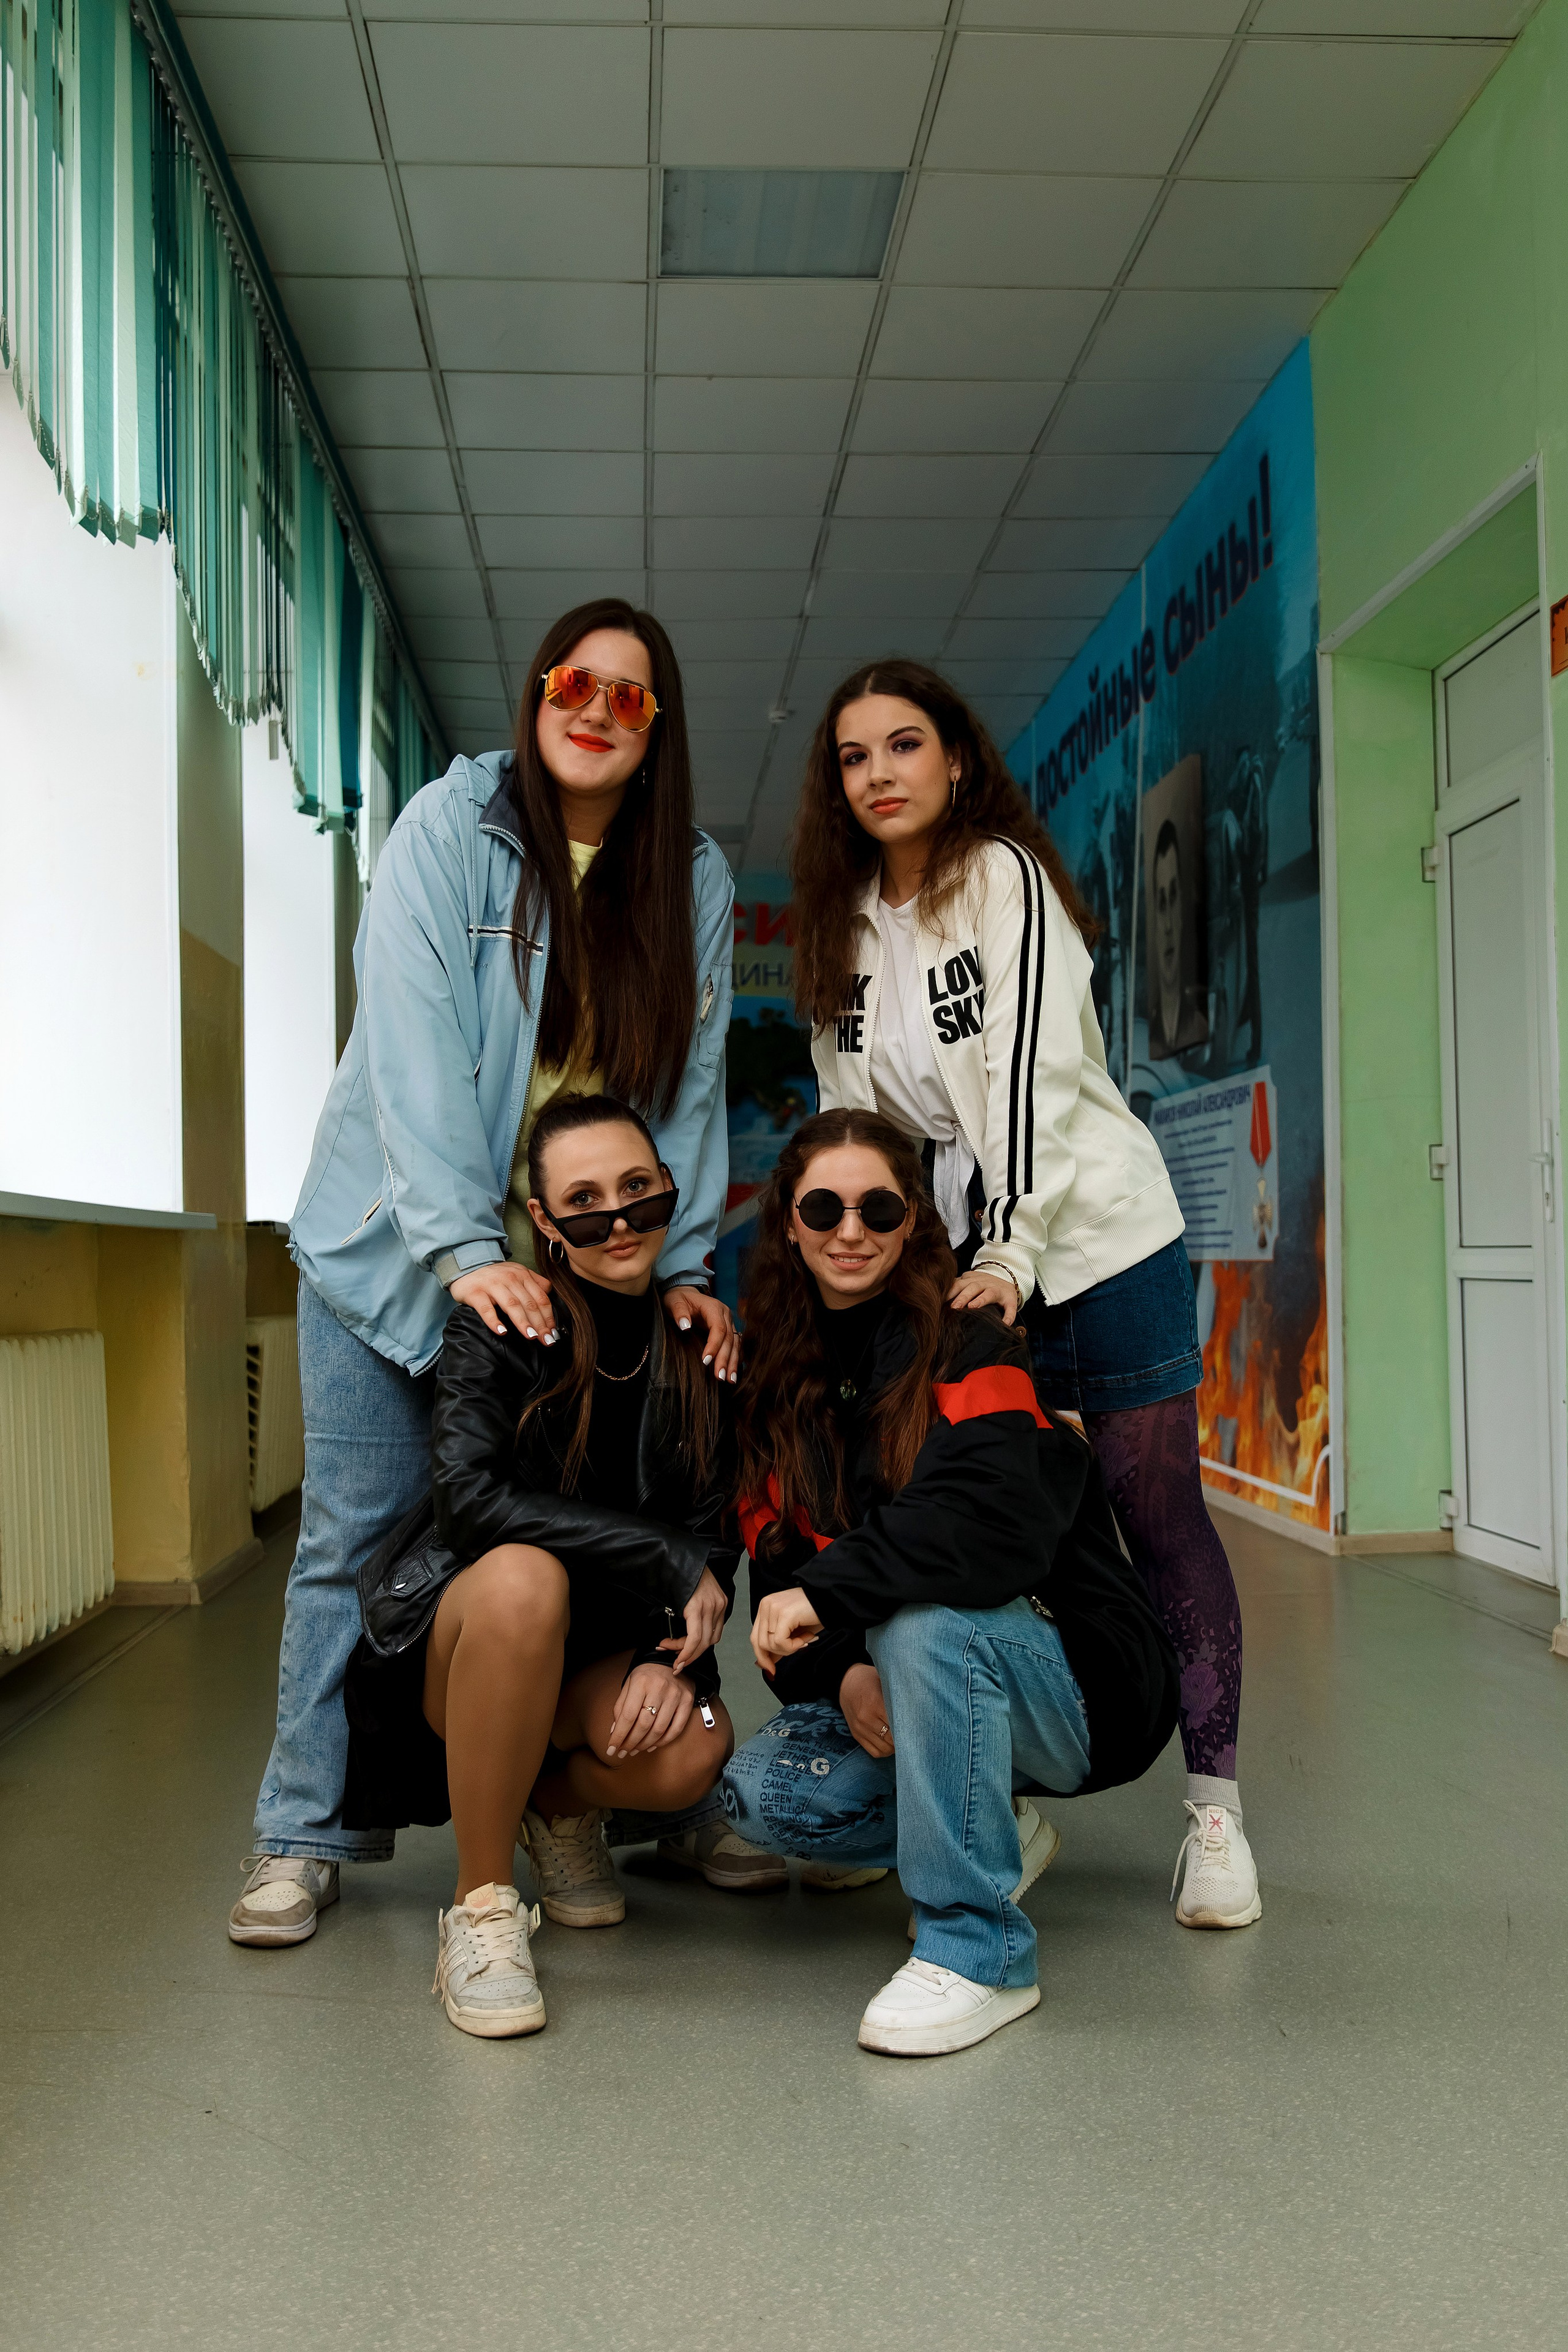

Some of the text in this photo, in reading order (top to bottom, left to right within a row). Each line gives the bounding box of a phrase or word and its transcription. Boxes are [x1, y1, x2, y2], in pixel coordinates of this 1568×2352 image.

[761, 1728, 791, 1738] D&G
[764, 1768, 802, 1783] POLICE
[761, 1779, 794, 1793] CAMEL
[760, 1792, 793, 1804] QUEEN
[760, 1803, 806, 1815] METALLICA
